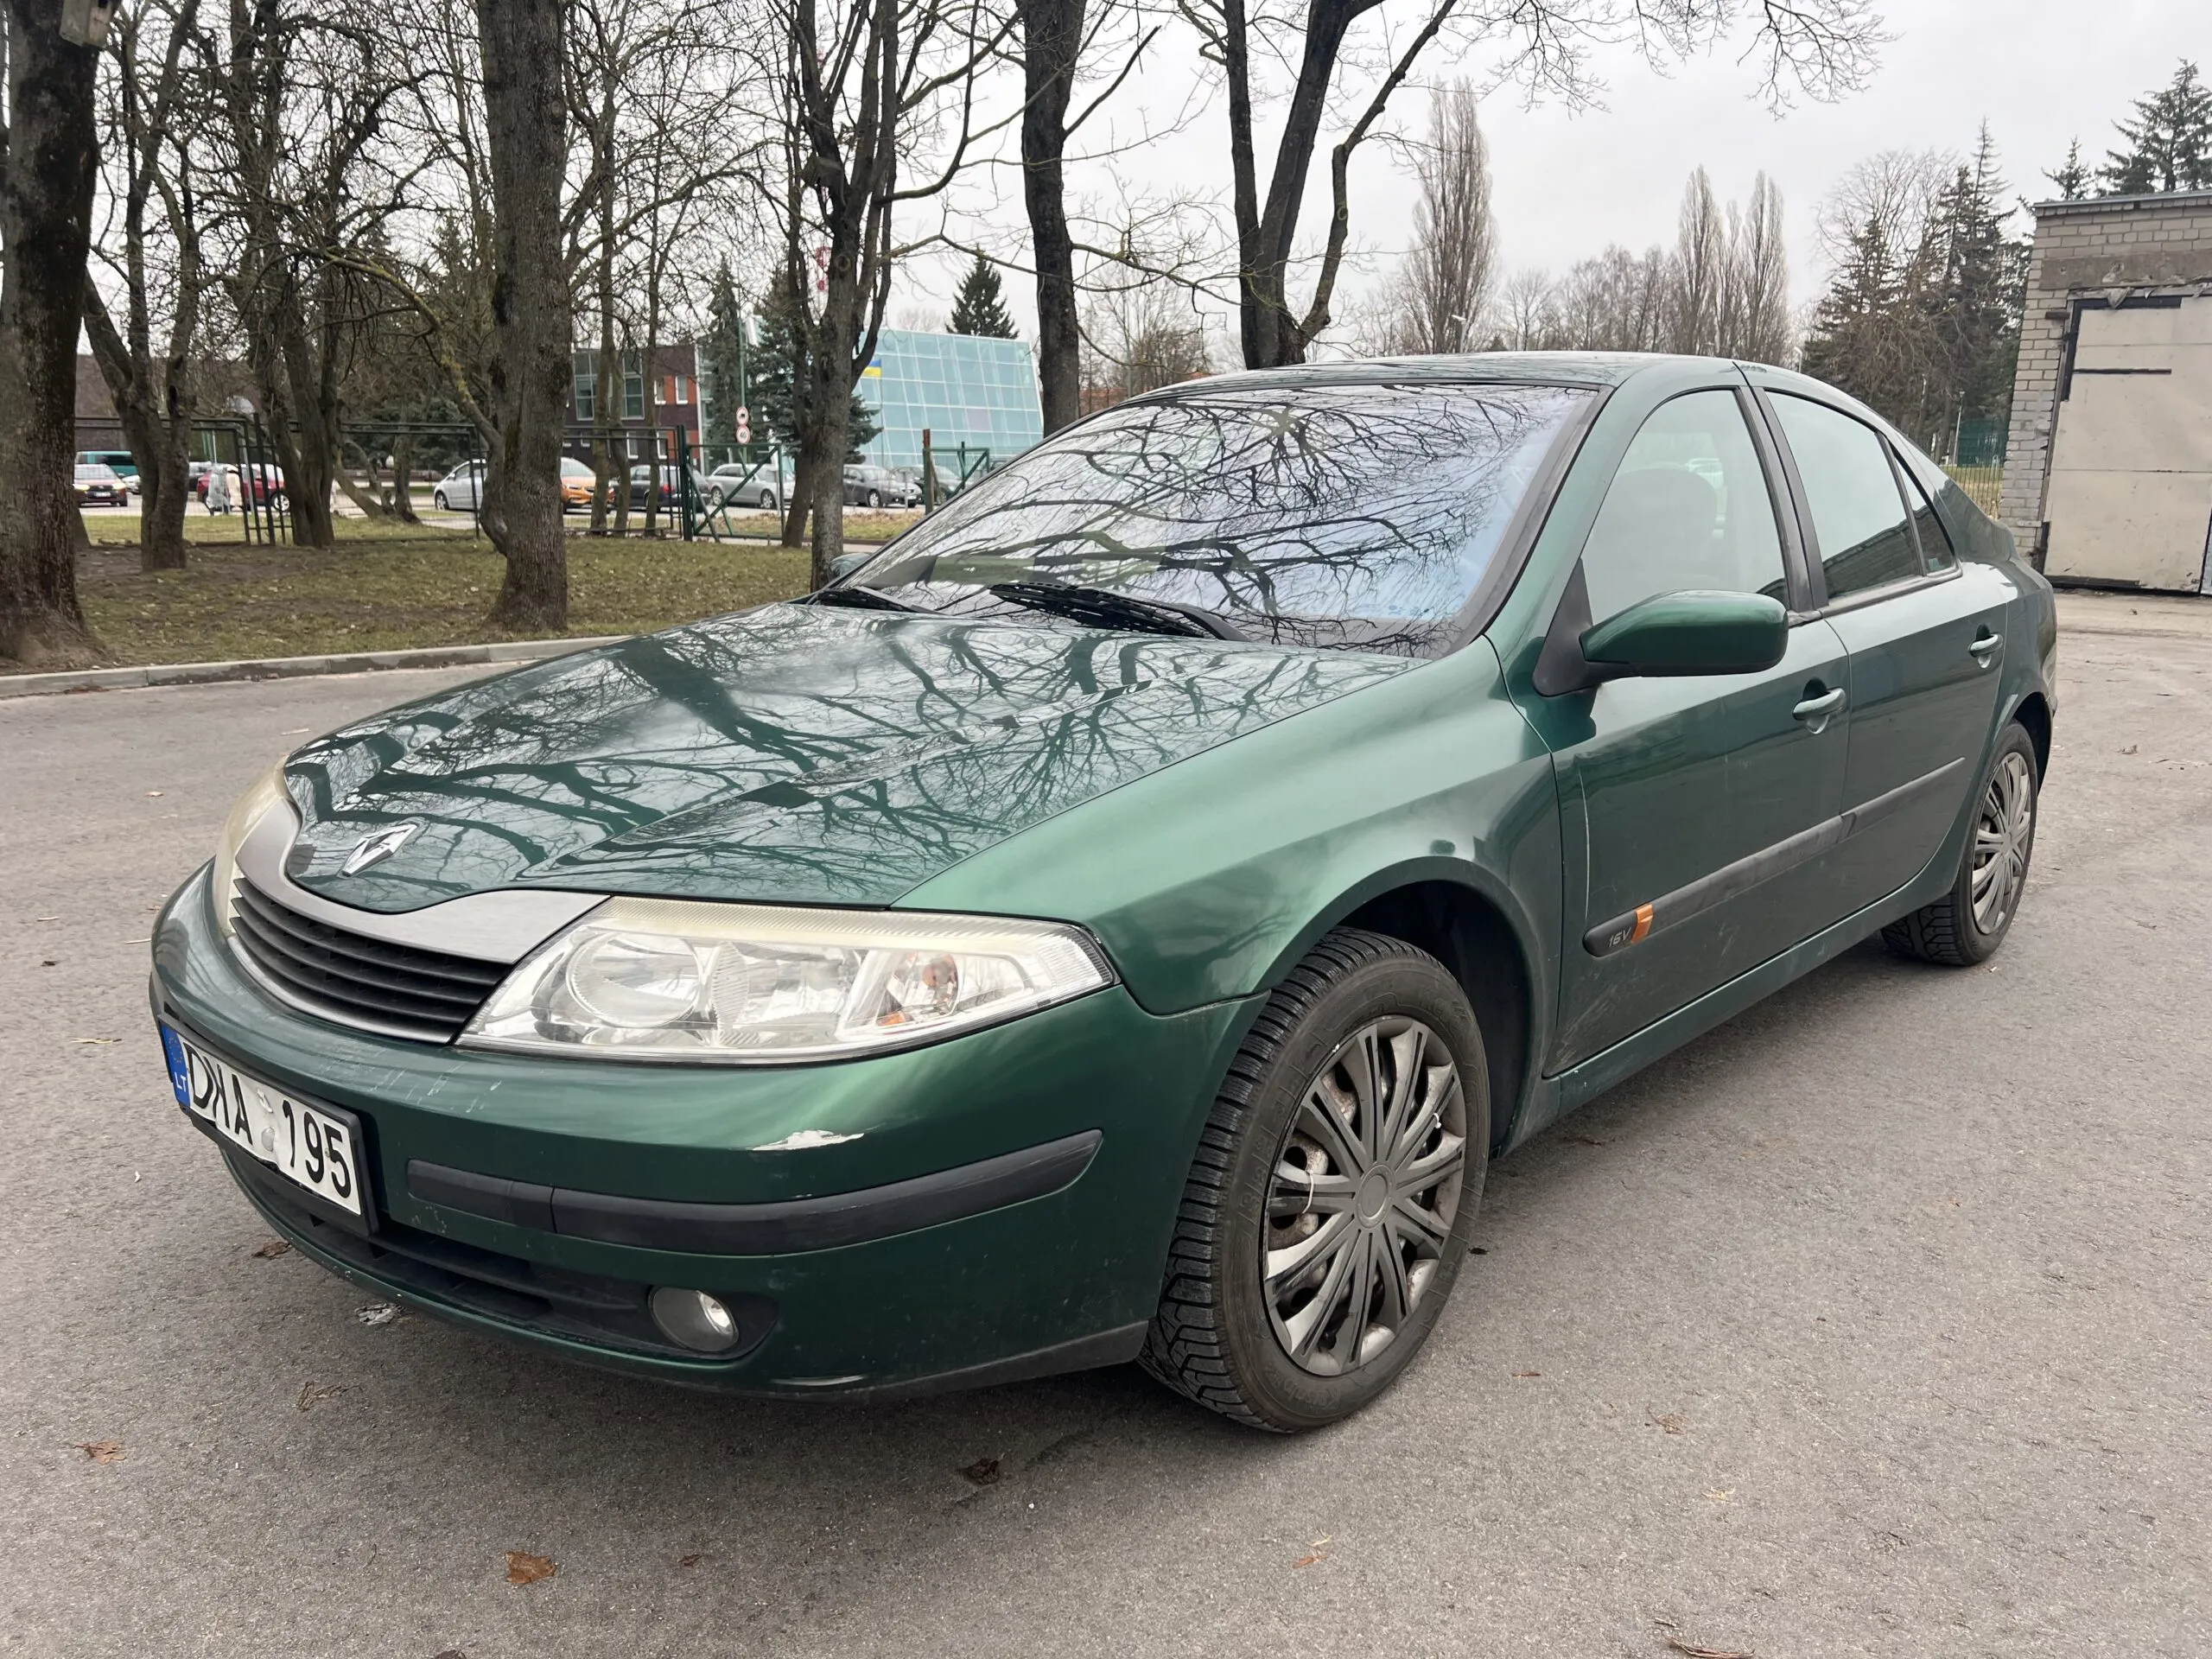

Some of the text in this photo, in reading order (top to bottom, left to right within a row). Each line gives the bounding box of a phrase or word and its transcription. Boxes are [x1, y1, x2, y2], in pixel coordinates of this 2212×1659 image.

[1609, 927, 1631, 947] 16V
[174, 1072, 188, 1097] LT
[283, 1100, 351, 1198] 195
